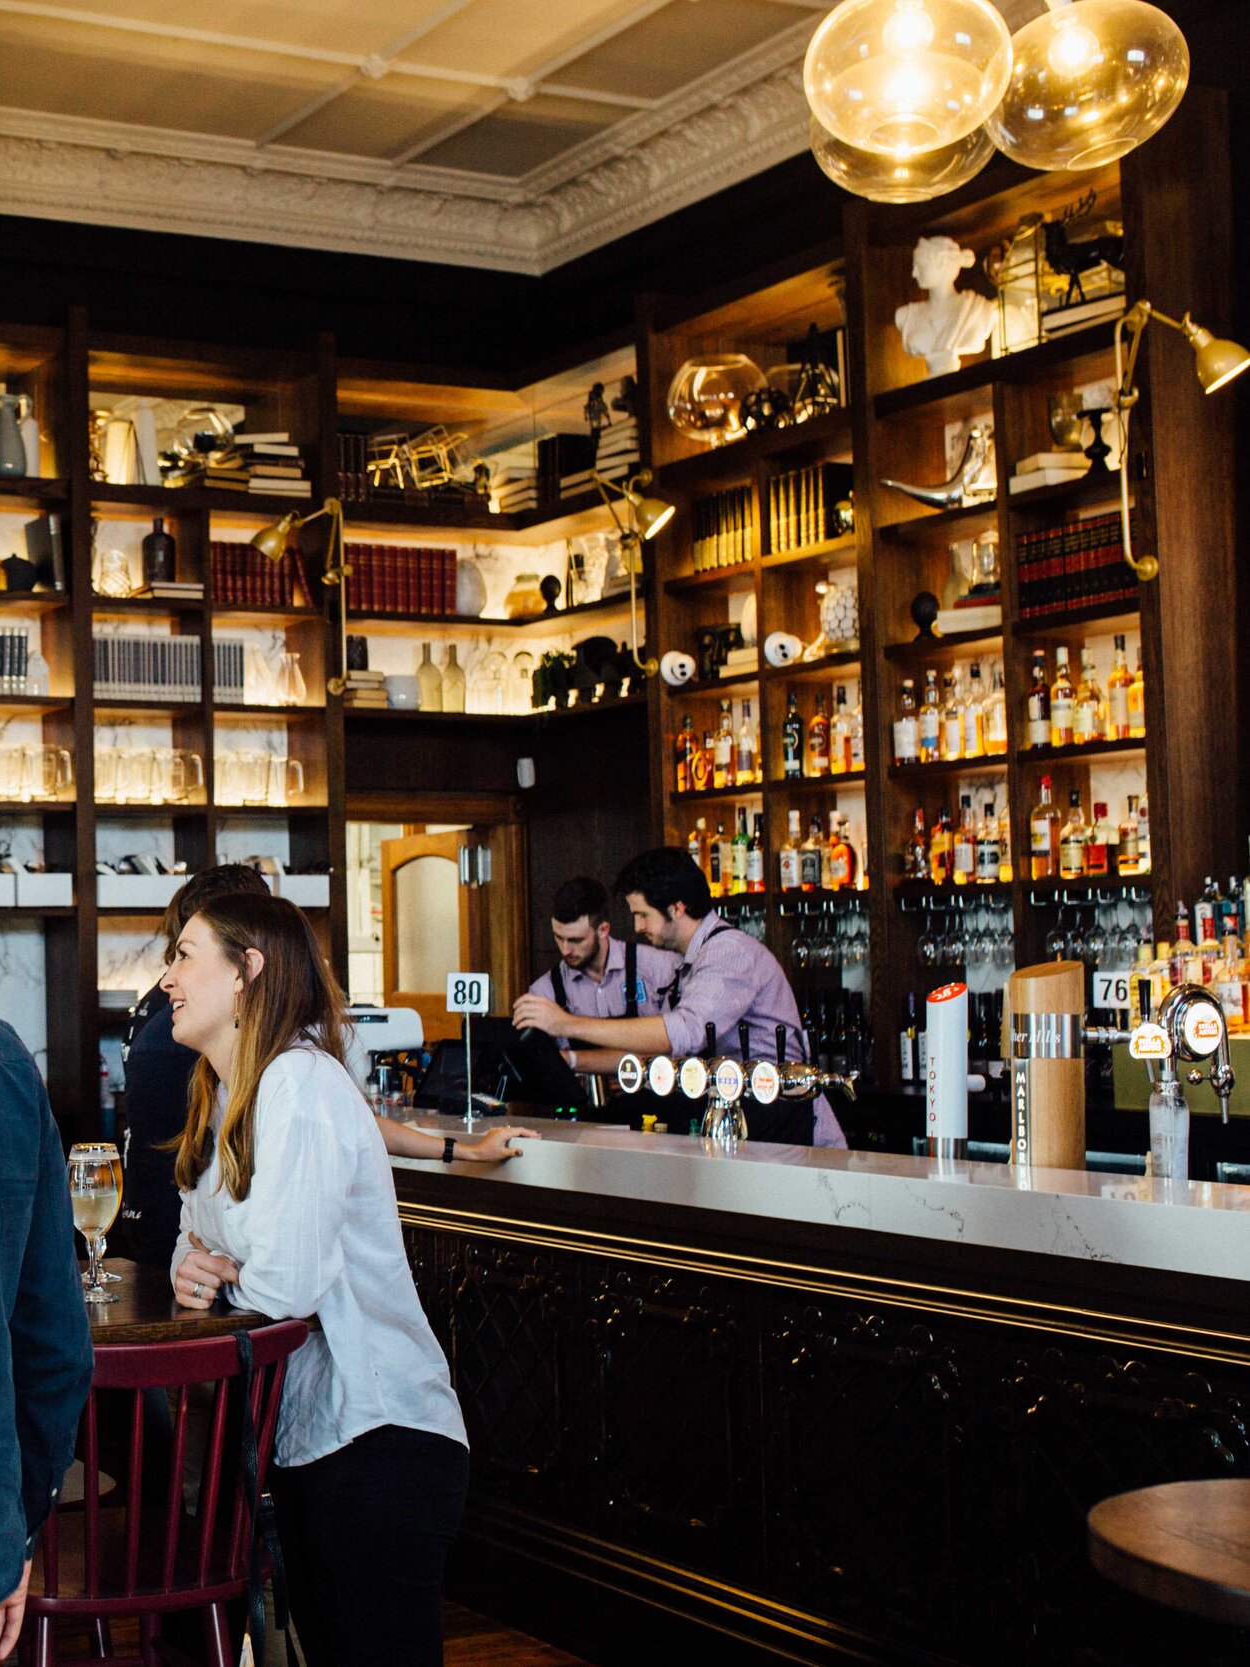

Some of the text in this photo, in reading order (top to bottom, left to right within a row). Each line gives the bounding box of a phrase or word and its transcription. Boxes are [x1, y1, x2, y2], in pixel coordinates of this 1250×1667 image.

[454, 980, 481, 1005] 80
[1099, 979, 1128, 1002] 76
[929, 1057, 937, 1122] TOKYO
